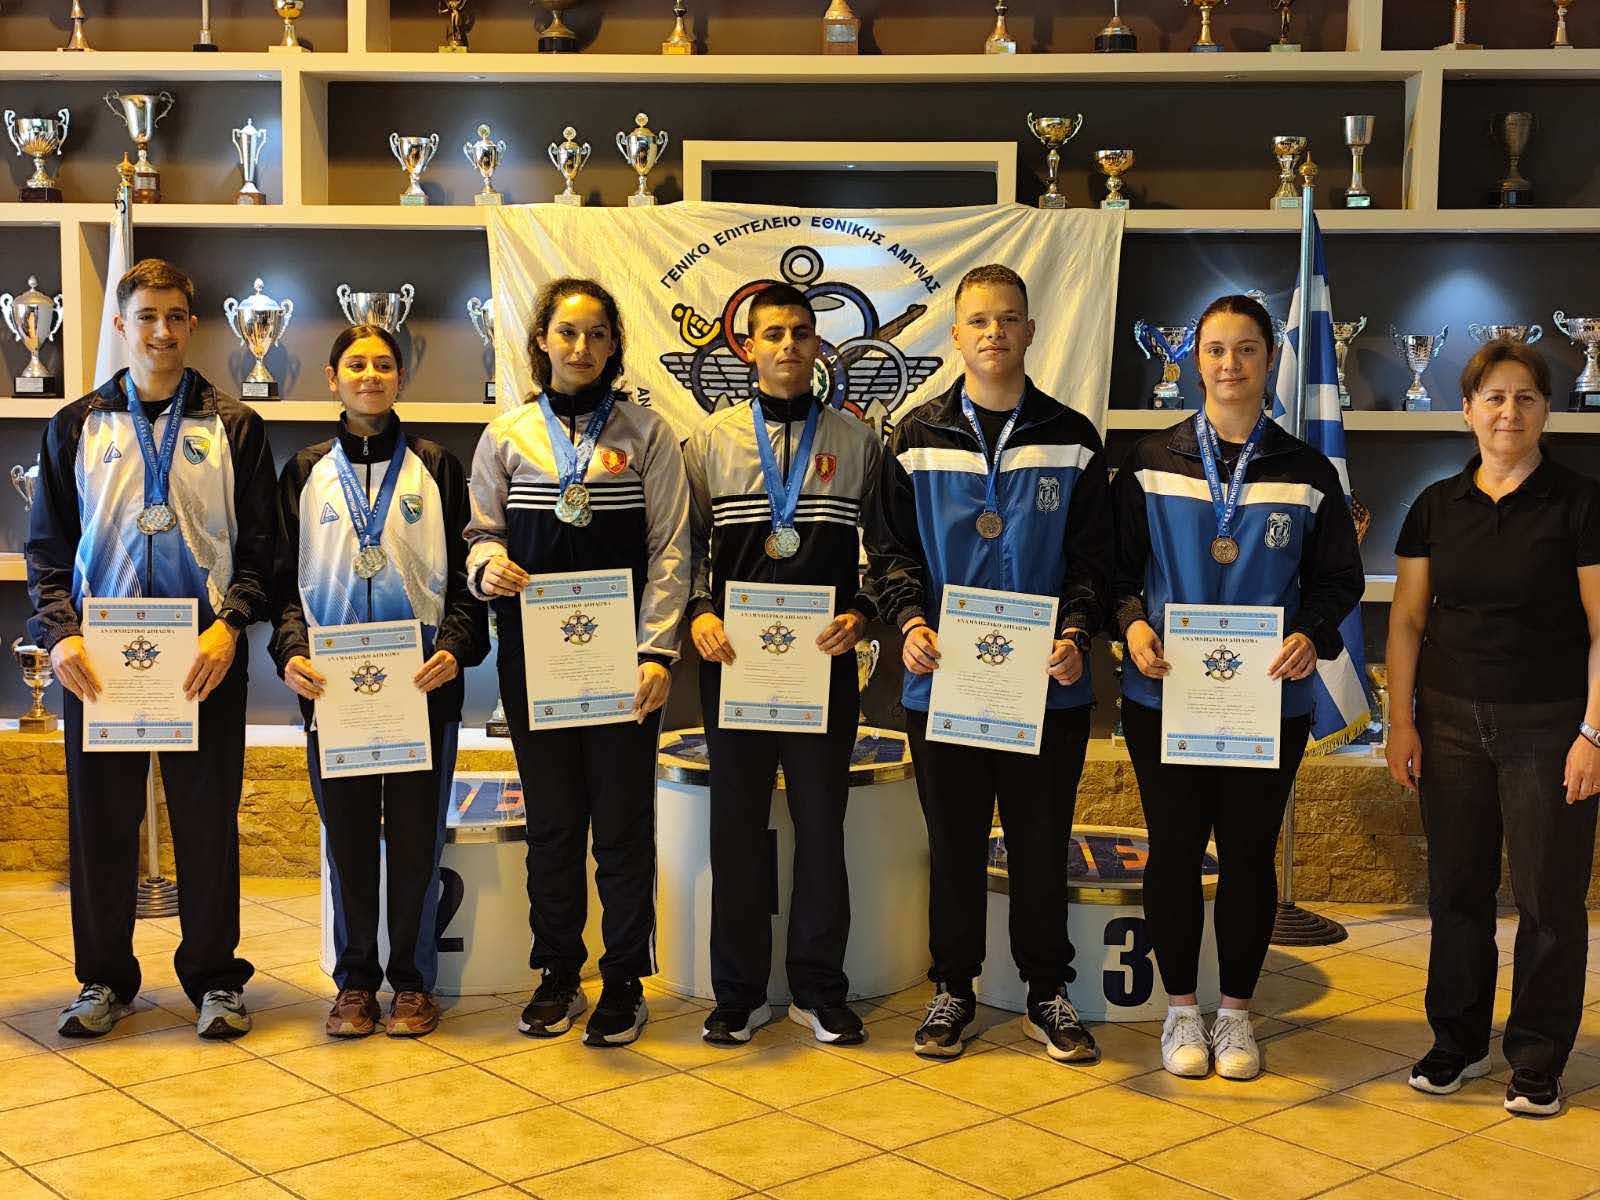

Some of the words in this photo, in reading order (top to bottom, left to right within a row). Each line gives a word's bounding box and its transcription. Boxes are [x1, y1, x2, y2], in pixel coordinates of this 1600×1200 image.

[660, 243, 710, 289] ΓΕΝΙΚΟ
[713, 216, 801, 246] ΕΠΙΤΕΛΕΙΟ
[811, 216, 885, 246] ΕΘΝΙΚΗΣ
[887, 243, 941, 294] ΑΜΥΝΑΣ
[1103, 916, 1153, 1008] 3
